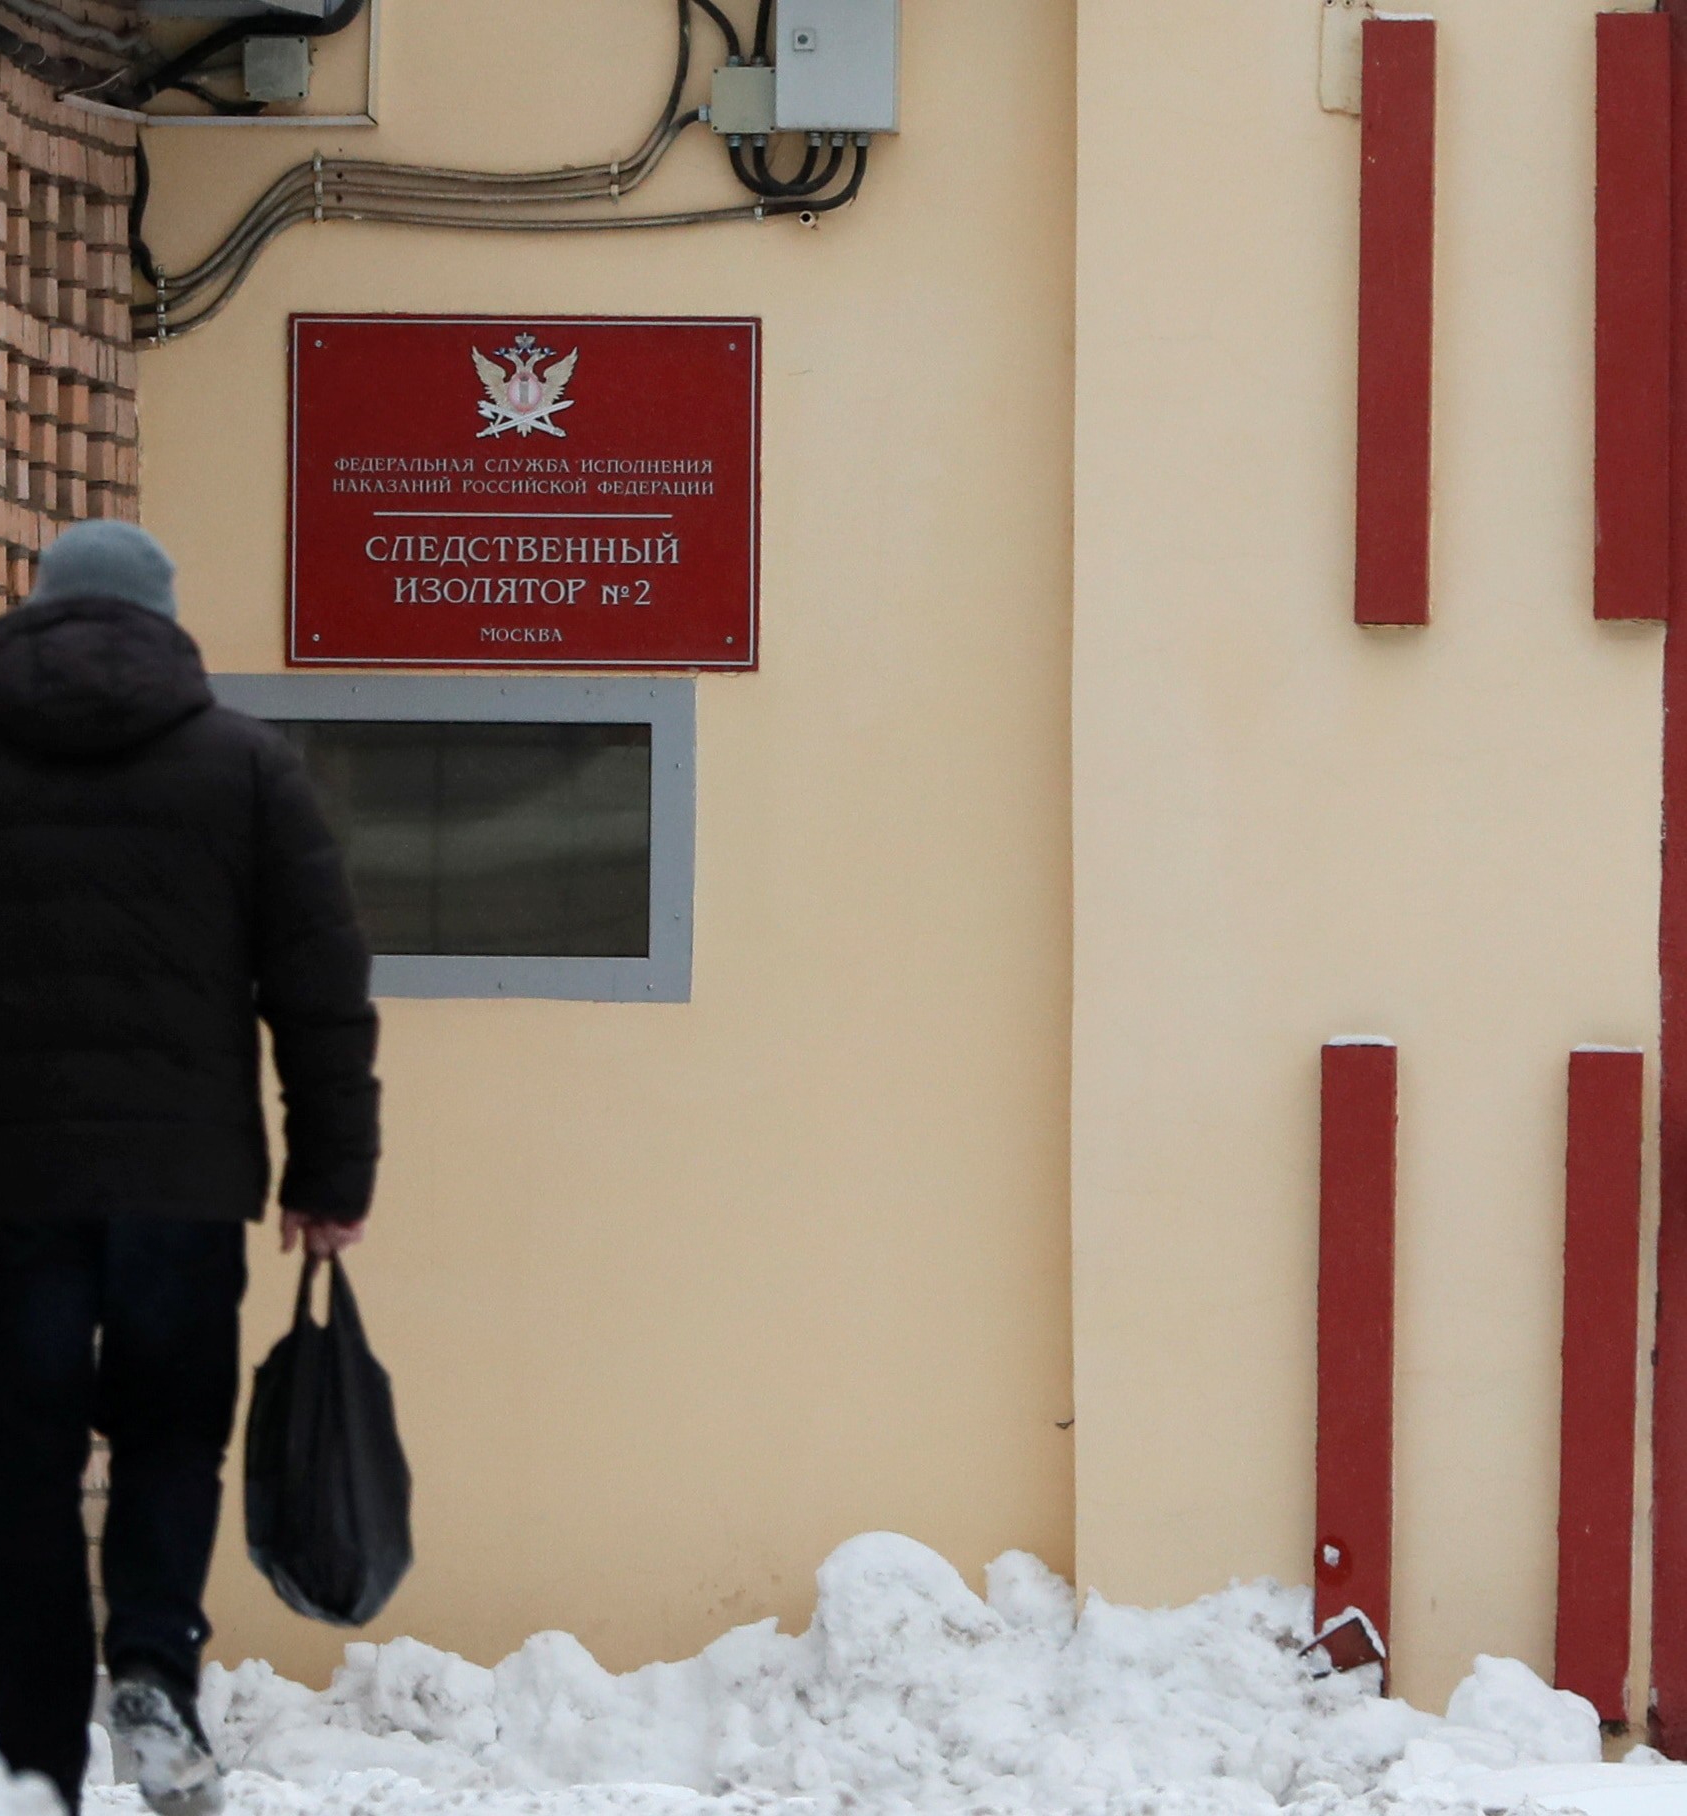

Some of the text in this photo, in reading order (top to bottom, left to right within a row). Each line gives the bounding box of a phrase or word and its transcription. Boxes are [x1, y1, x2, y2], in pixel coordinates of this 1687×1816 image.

[334, 458, 712, 475] ФЕДЕРАЛЬНАЯ СЛУЖБА ИСПОЛНЕНИЯ
[332, 476, 713, 496] НАКАЗАНИЙ РОССИЙСКОЙ ФЕДЕРАЦИИ
[365, 532, 679, 567] СЛЕДСТВЕННЫЙ
[394, 578, 651, 606] ИЗОЛЯТОР №2
[480, 627, 563, 642] МОСКВА
